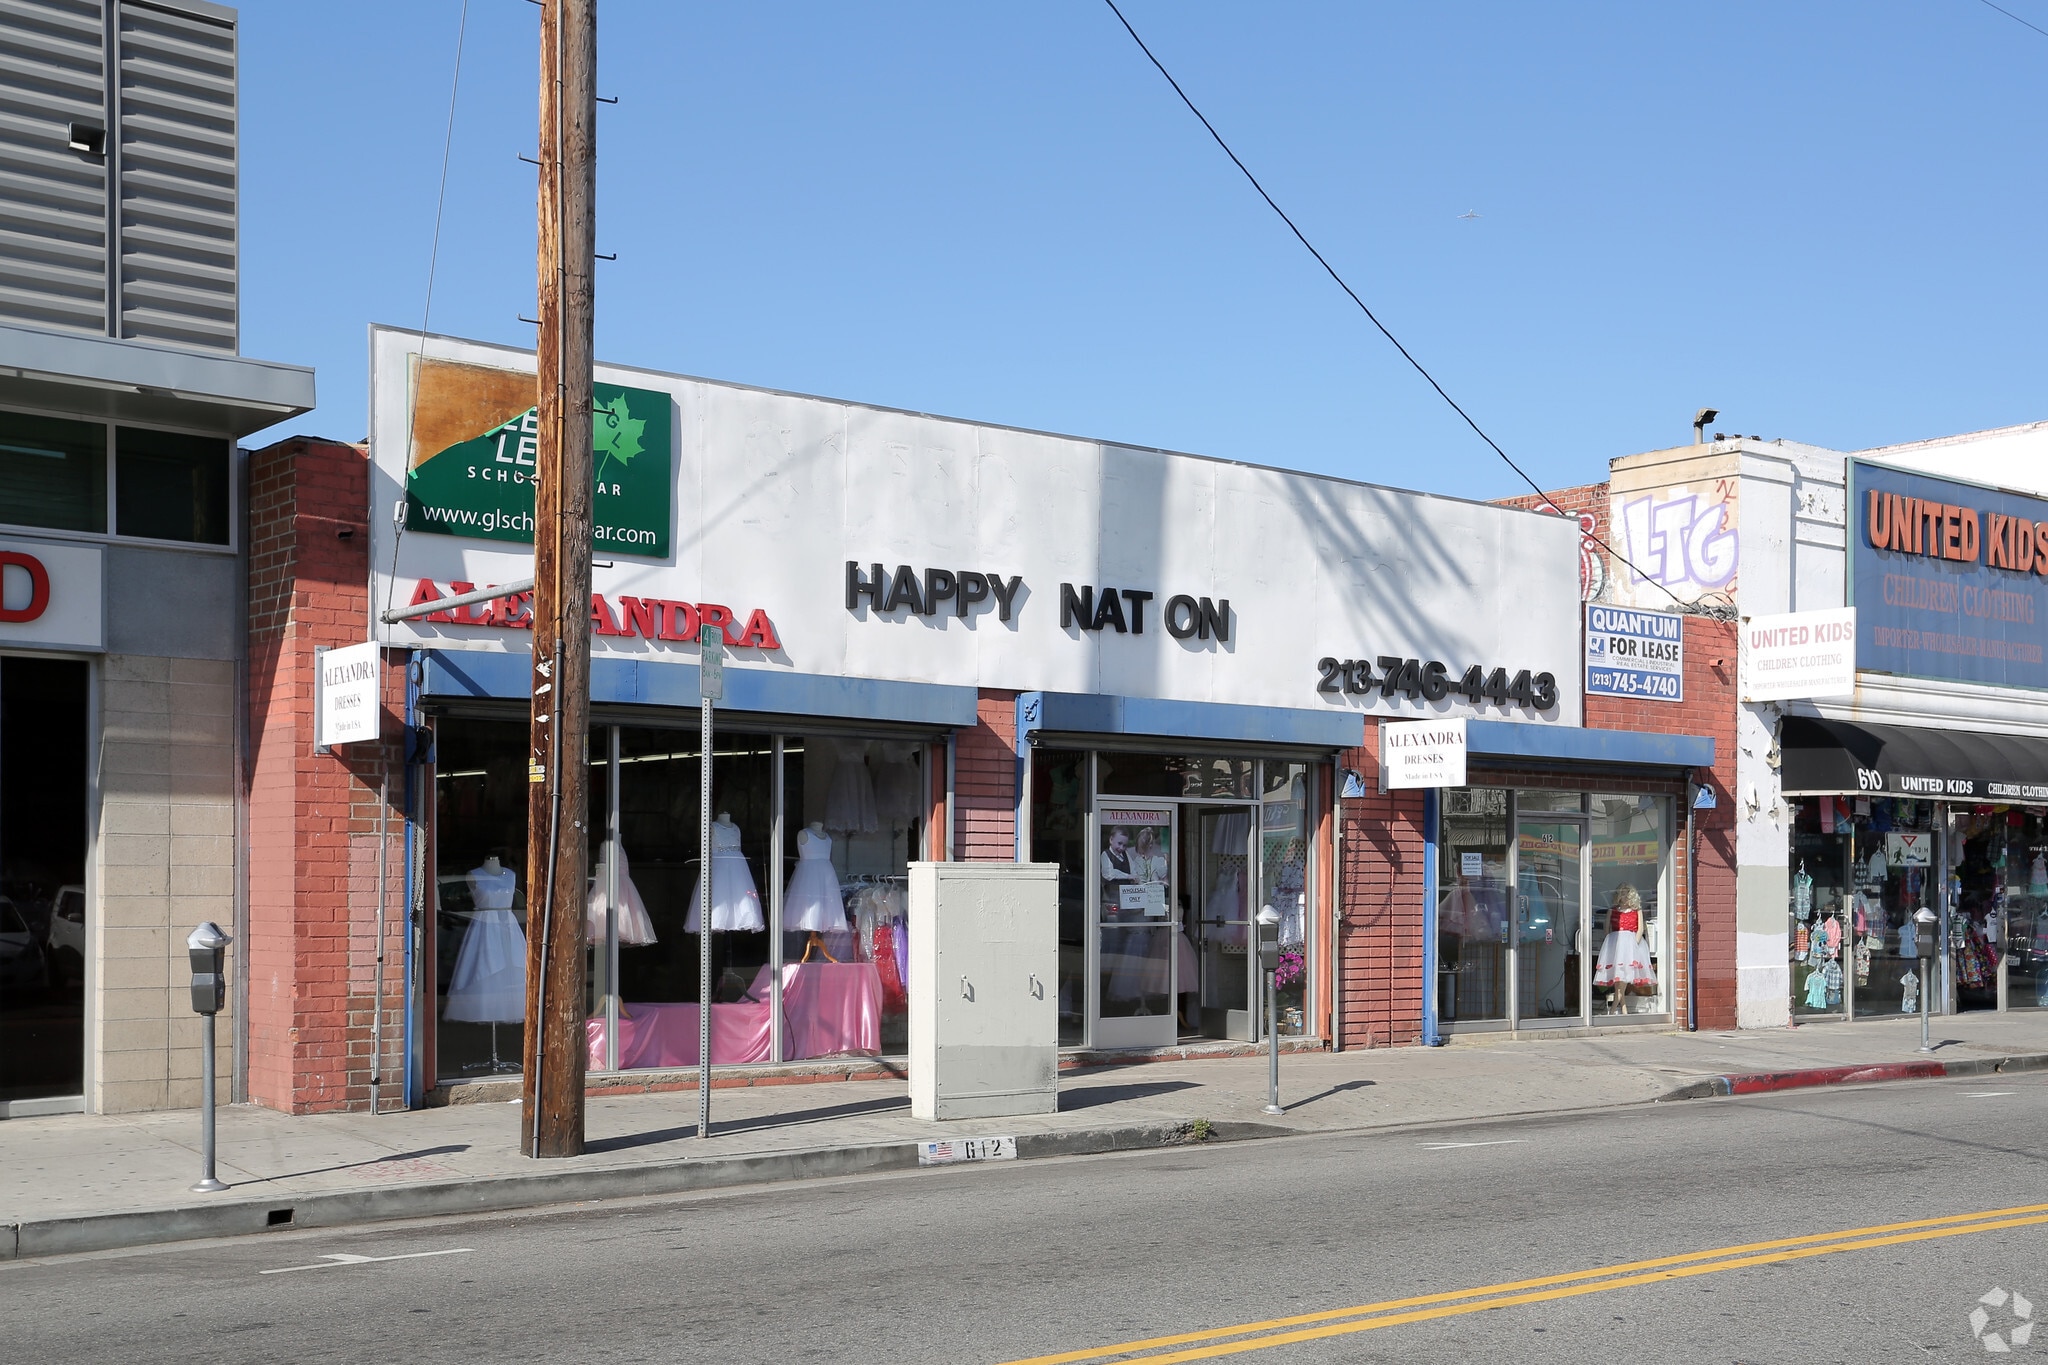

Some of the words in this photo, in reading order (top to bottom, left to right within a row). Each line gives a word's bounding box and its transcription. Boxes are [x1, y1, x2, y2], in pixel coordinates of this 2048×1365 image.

[1868, 489, 1980, 562] UNITED
[1986, 511, 2048, 576] KIDS
[845, 560, 1023, 621] HAPPY
[1883, 573, 1959, 614] CHILDREN
[1963, 585, 2035, 625] CLOTHING
[1592, 608, 1678, 639] QUANTUM
[703, 628, 709, 645] 4
[1751, 625, 1809, 649] UNITED
[1814, 620, 1853, 644] KIDS
[702, 649, 722, 665] PARKING
[1609, 636, 1637, 657] FOR
[1642, 640, 1679, 662] LEASE
[1612, 655, 1645, 664] COMMERCIAL
[1649, 659, 1675, 668] INDUSTRIAL
[1616, 660, 1630, 668] REAL
[1631, 662, 1648, 670] ESTATE
[1649, 664, 1672, 672] SERVICES
[1757, 656, 1798, 671] CHILDREN
[1800, 653, 1842, 668] CLOTHING
[323, 660, 375, 687] ALEXANDRA
[1317, 655, 1556, 710] 213-746-4443
[334, 693, 361, 711] DRESSES
[1387, 731, 1463, 748] ALEXANDRA
[1404, 753, 1444, 765] DRESSES
[1405, 772, 1421, 781] Made
[1422, 772, 1428, 780] in
[1857, 767, 1883, 791] 610
[1901, 776, 1944, 792] UNITED
[1946, 779, 1974, 795] KIDS
[1987, 782, 2021, 797] CHILDREN
[1109, 811, 1160, 821] ALEXANDRA
[1542, 833, 1554, 843] 612
[965, 1139, 1001, 1159] 612
